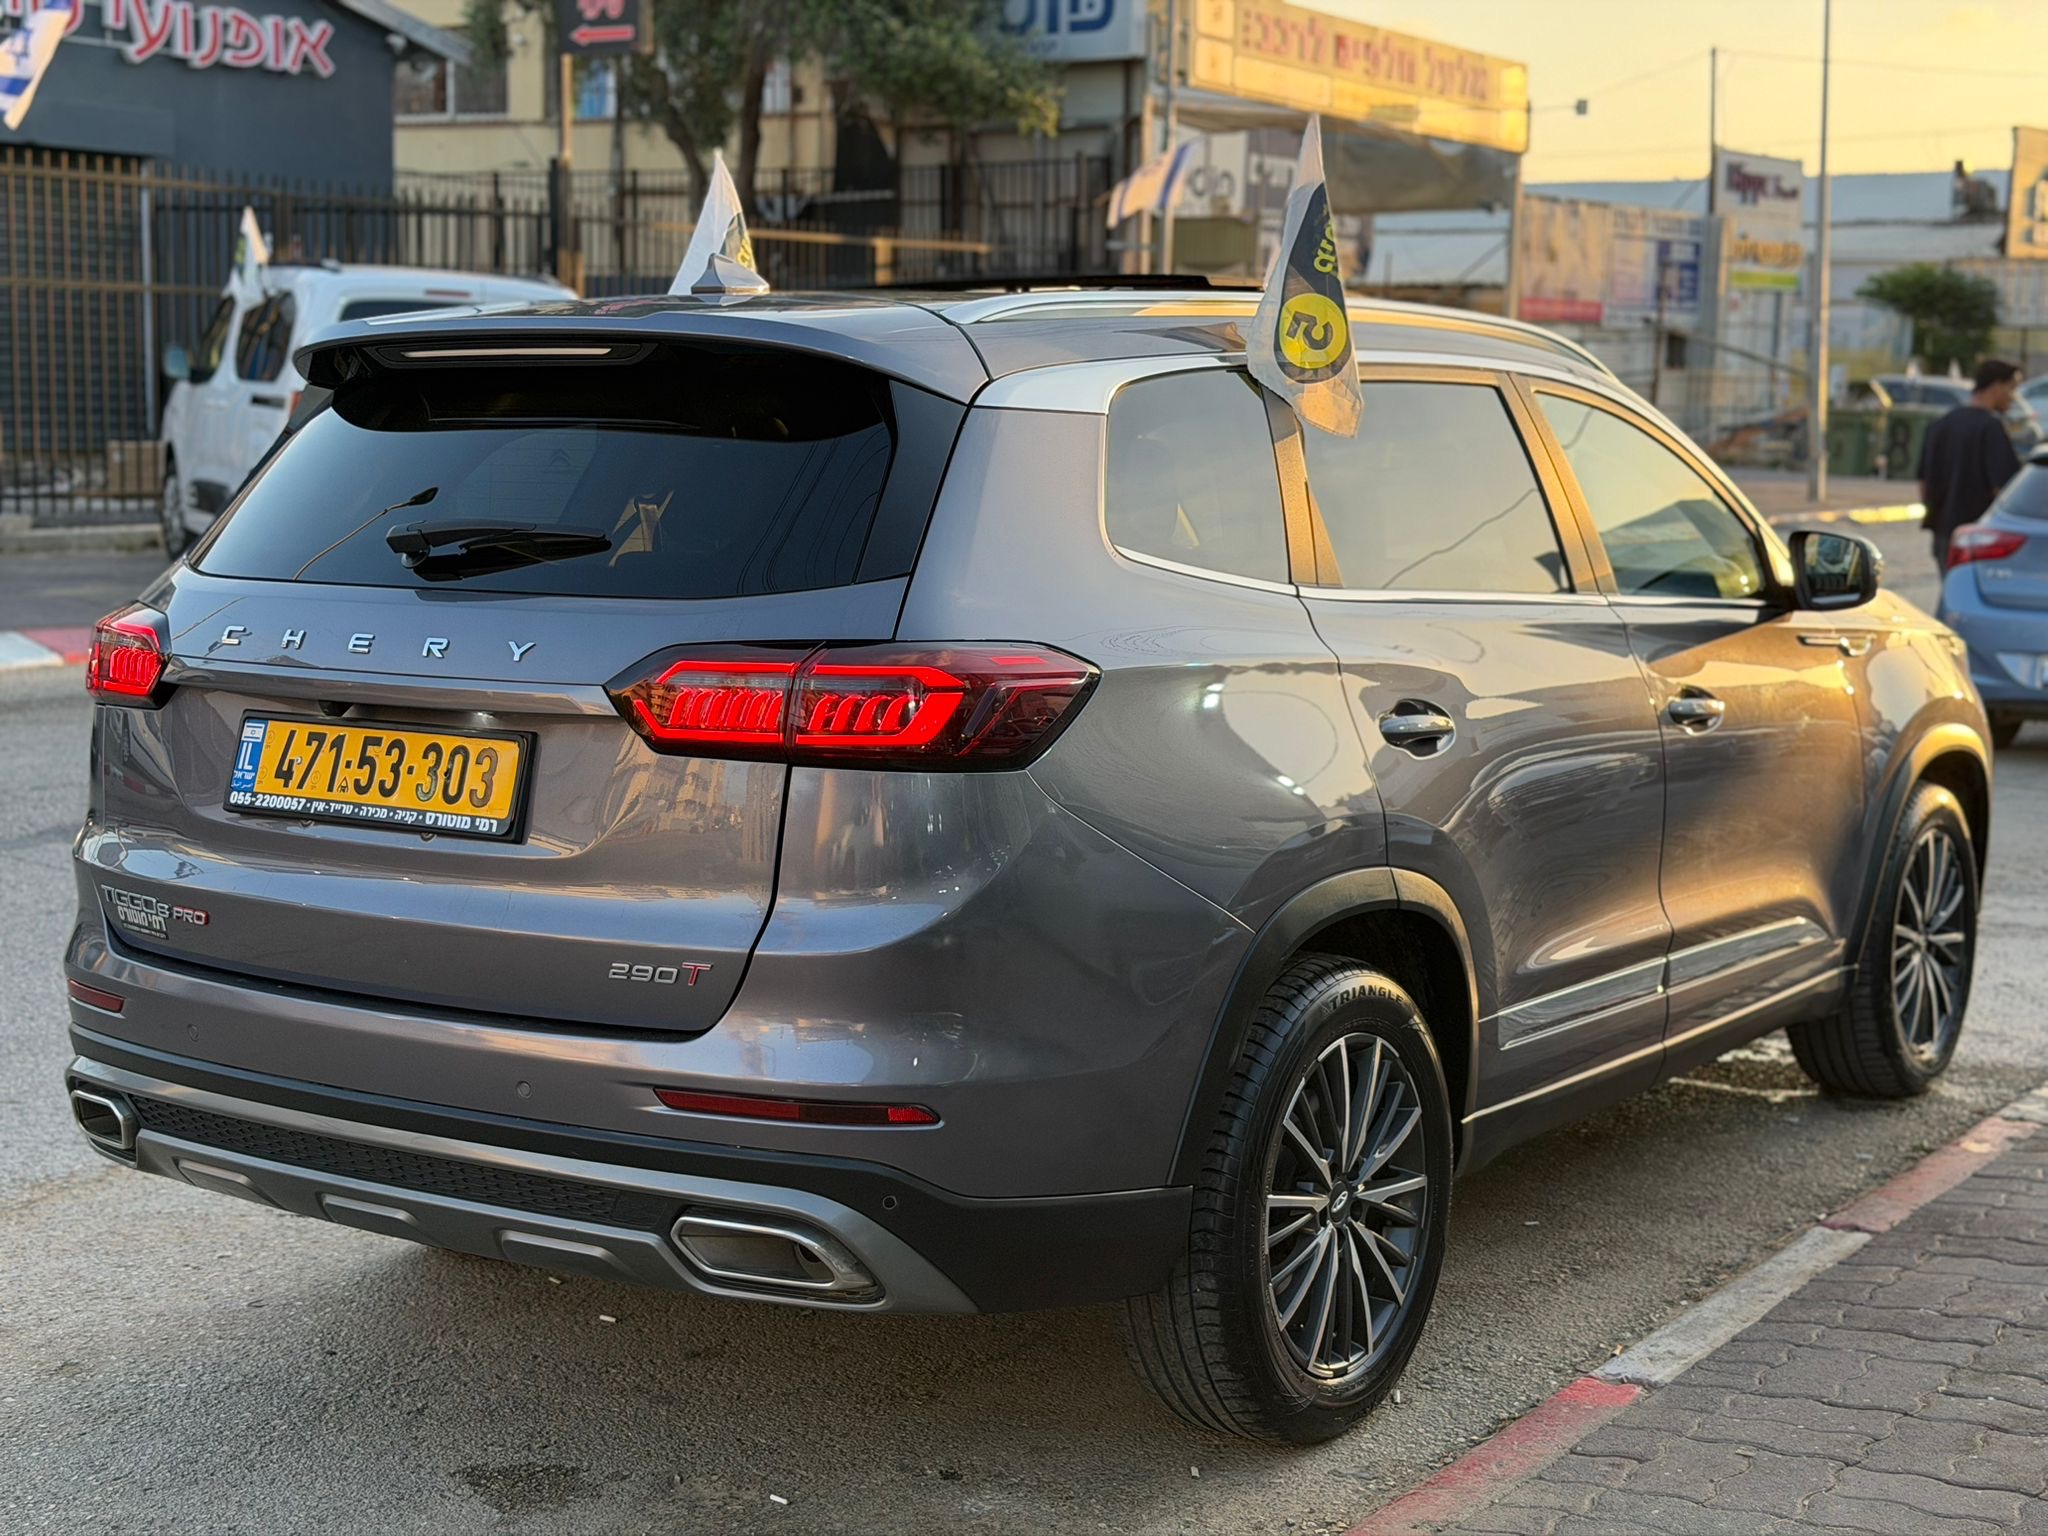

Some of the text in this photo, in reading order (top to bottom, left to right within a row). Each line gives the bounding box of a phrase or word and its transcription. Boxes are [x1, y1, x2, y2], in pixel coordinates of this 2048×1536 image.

[221, 625, 535, 662] CHERY
[238, 742, 253, 770] IL
[229, 791, 307, 811] 055-2200057
[359, 804, 388, 817] מכירה
[394, 809, 418, 824] קניה
[425, 812, 471, 829] מוטורס
[475, 818, 498, 833] רמי
[117, 905, 149, 927] מוטורס
[149, 912, 167, 932] רמי
[172, 906, 208, 926] PRO
[1327, 984, 1405, 1012] TRIANGLE
